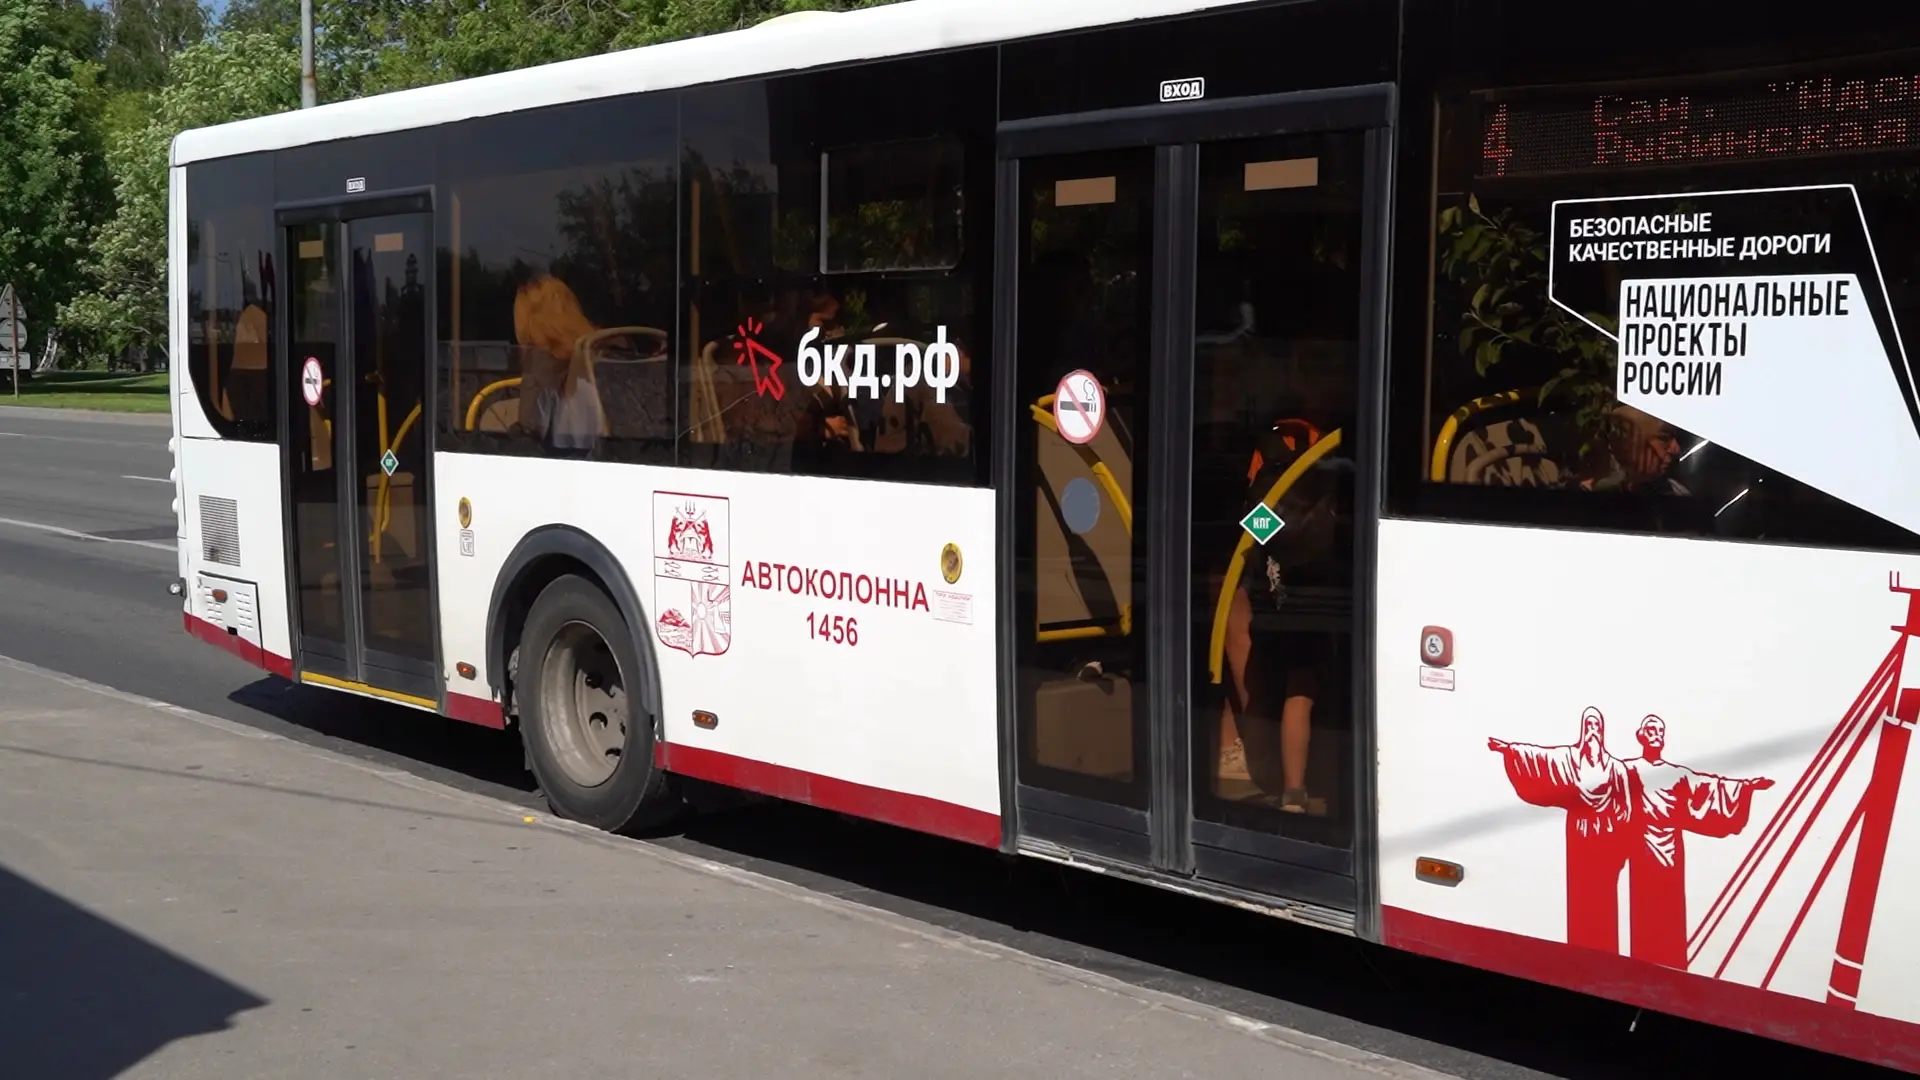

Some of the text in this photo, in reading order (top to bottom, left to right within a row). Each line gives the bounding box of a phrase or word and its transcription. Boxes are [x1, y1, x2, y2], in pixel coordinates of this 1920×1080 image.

[1163, 81, 1200, 98] ВХОД
[1484, 104, 1513, 176] 4
[1592, 117, 1907, 165] Рыбинская
[1569, 212, 1712, 238] БЕЗОПАСНЫЕ
[1569, 233, 1831, 262] КАЧЕСТВЕННЫЕ ДОРОГИ
[1625, 280, 1850, 321] НАЦИОНАЛЬНЫЕ
[1624, 322, 1747, 357] ПРОЕКТЫ
[797, 325, 960, 404] бкд.рф
[1623, 361, 1722, 396] РОССИИ
[1252, 517, 1271, 530] КПГ
[741, 560, 930, 612] АВТОКОЛОННА
[806, 611, 858, 647] 1456
